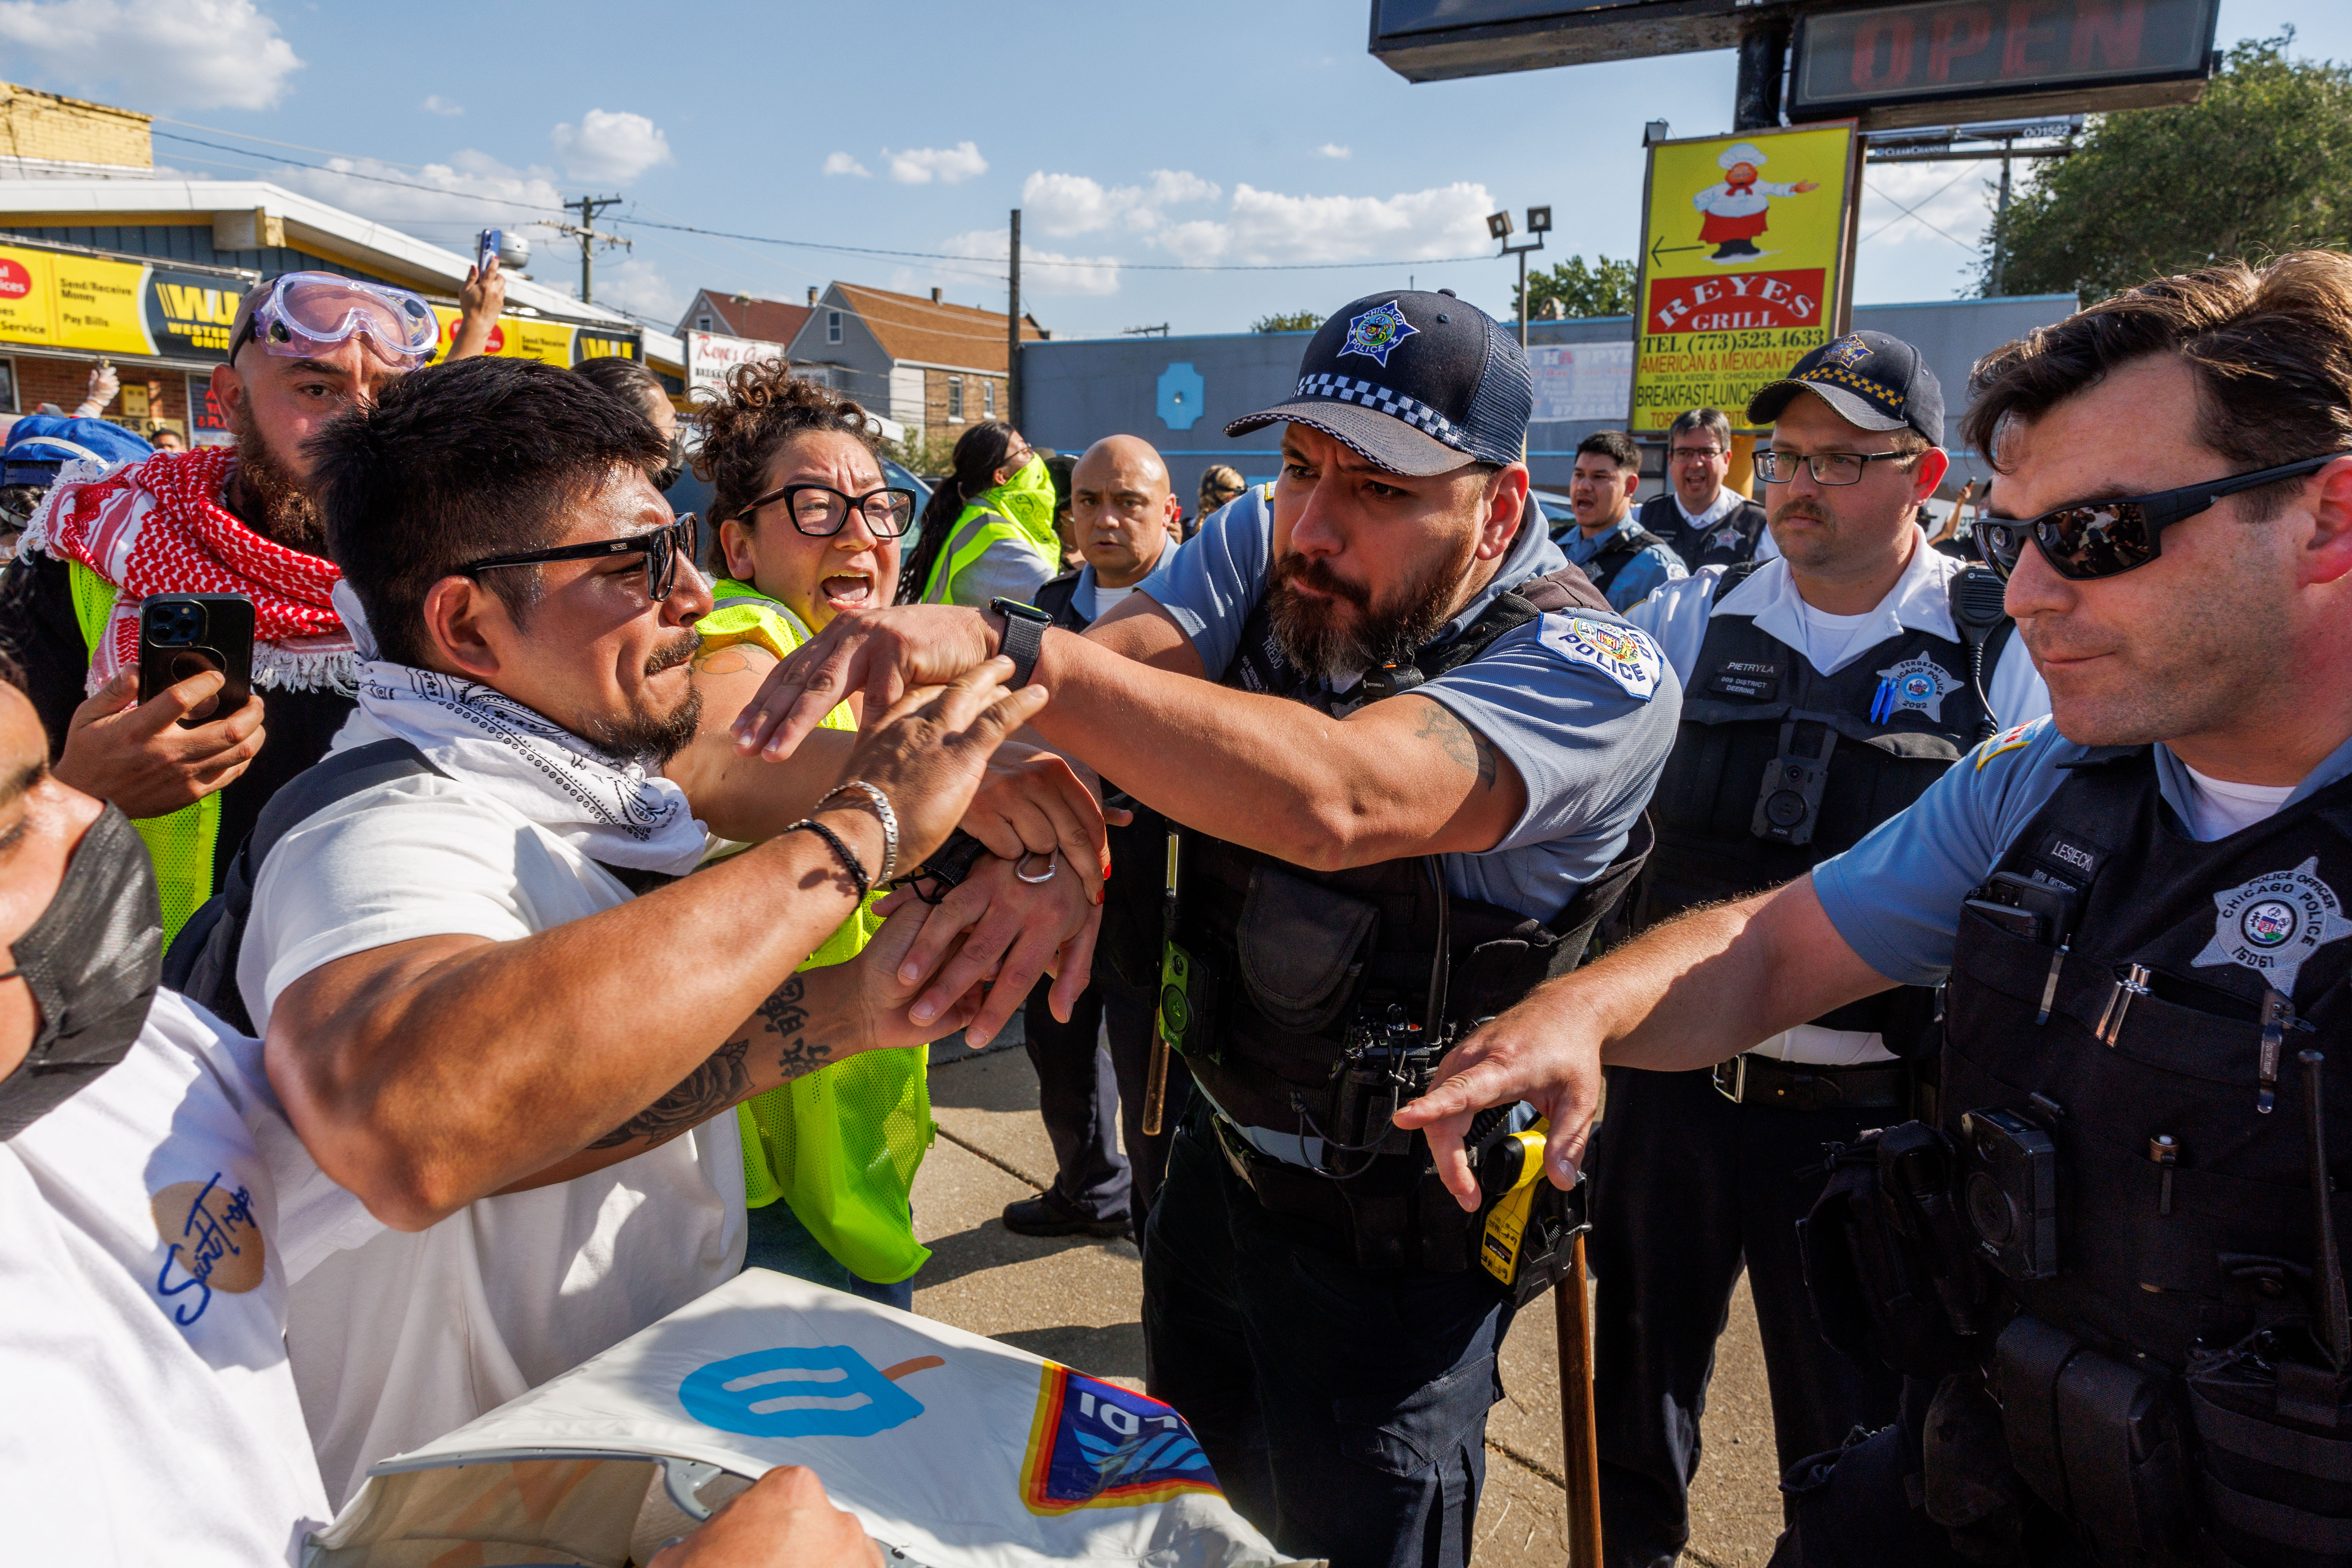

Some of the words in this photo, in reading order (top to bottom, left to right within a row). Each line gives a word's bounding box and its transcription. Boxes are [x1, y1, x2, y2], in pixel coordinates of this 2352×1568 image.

[1852, 0, 2144, 93] OPEN
[61, 289, 96, 303] Money
[1655, 274, 1815, 330] REYES
[63, 313, 81, 326] Pay
[84, 315, 109, 327] Bills
[1363, 307, 1403, 326] CHICAGO
[1691, 310, 1778, 331] GRILL
[0, 320, 46, 335] Service
[167, 321, 230, 339] WESTER
[191, 336, 229, 350] UNIO
[1349, 338, 1385, 353] POLICE
[1643, 335, 1682, 354] TEL
[1688, 329, 1825, 355] (773)523.4633
[1640, 354, 1707, 373] AMERICAN
[1709, 354, 1718, 371] &
[1724, 352, 1782, 370] MEXICAN
[1262, 635, 1284, 669] TREJO
[1558, 633, 1646, 682] POLICE
[1726, 662, 1774, 673] PIETRYLA
[1900, 661, 1944, 673] SERGEANT
[1726, 684, 1755, 695] DEERING
[1735, 678, 1768, 688] DISTRICT
[1927, 670, 1944, 696] POLICE
[2050, 841, 2094, 872] LESIECKI
[2249, 872, 2294, 887] POLICE
[2296, 874, 2336, 909] OFFICER
[2222, 883, 2294, 918] CHICAGO
[2299, 892, 2323, 947] POLICE
